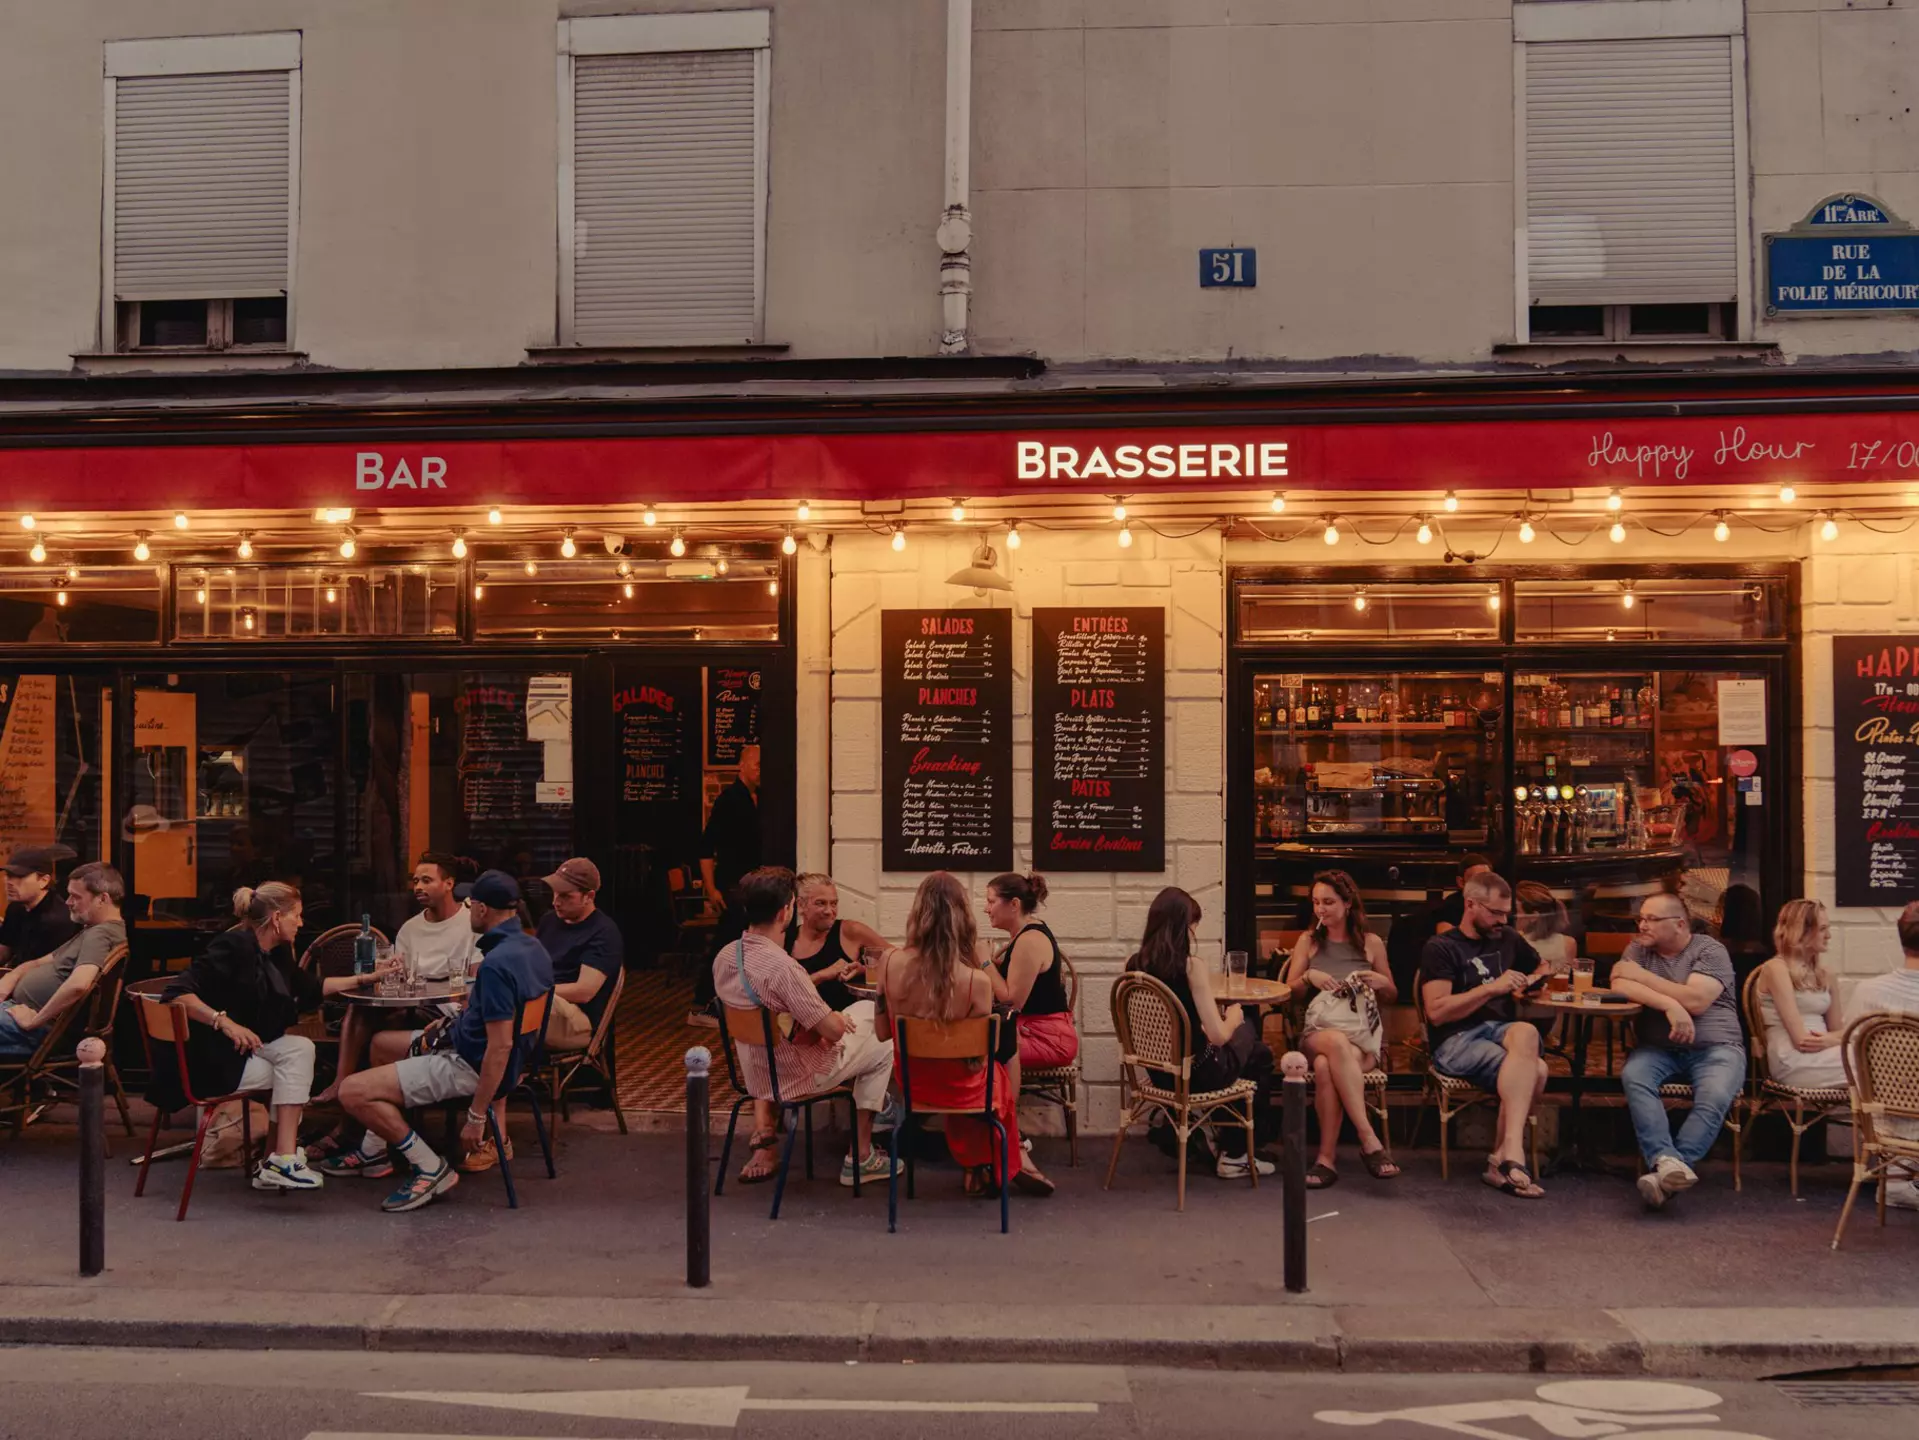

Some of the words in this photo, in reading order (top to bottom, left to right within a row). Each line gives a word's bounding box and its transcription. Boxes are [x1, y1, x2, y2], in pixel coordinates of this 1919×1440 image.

[1832, 245, 1870, 260] RUE
[1212, 252, 1244, 282] 51
[1822, 265, 1846, 280] DE
[1857, 265, 1880, 280] LA
[1777, 286, 1828, 301] FOLIE
[1017, 441, 1288, 480] BRASSERIE
[1588, 431, 1694, 479] Happy
[1714, 426, 1815, 465] Hour
[1846, 440, 1919, 470] 17/0
[356, 452, 448, 490] BAR
[921, 617, 974, 635] SALADES
[1073, 615, 1129, 633] ENTRÉES
[904, 648, 923, 658] Salade
[905, 639, 926, 649] Salade
[1093, 640, 1119, 649] Canard
[904, 659, 923, 669] Salade
[903, 669, 922, 680] Salade
[614, 685, 675, 713] SALADES
[918, 688, 977, 706] PLANCHES
[1070, 688, 1115, 709] PLATS
[1855, 716, 1904, 746] Pintes
[909, 746, 982, 776] Snacking
[626, 764, 665, 779] PLANCHES
[1071, 779, 1112, 797] PATES
[904, 838, 946, 855] Assiette
